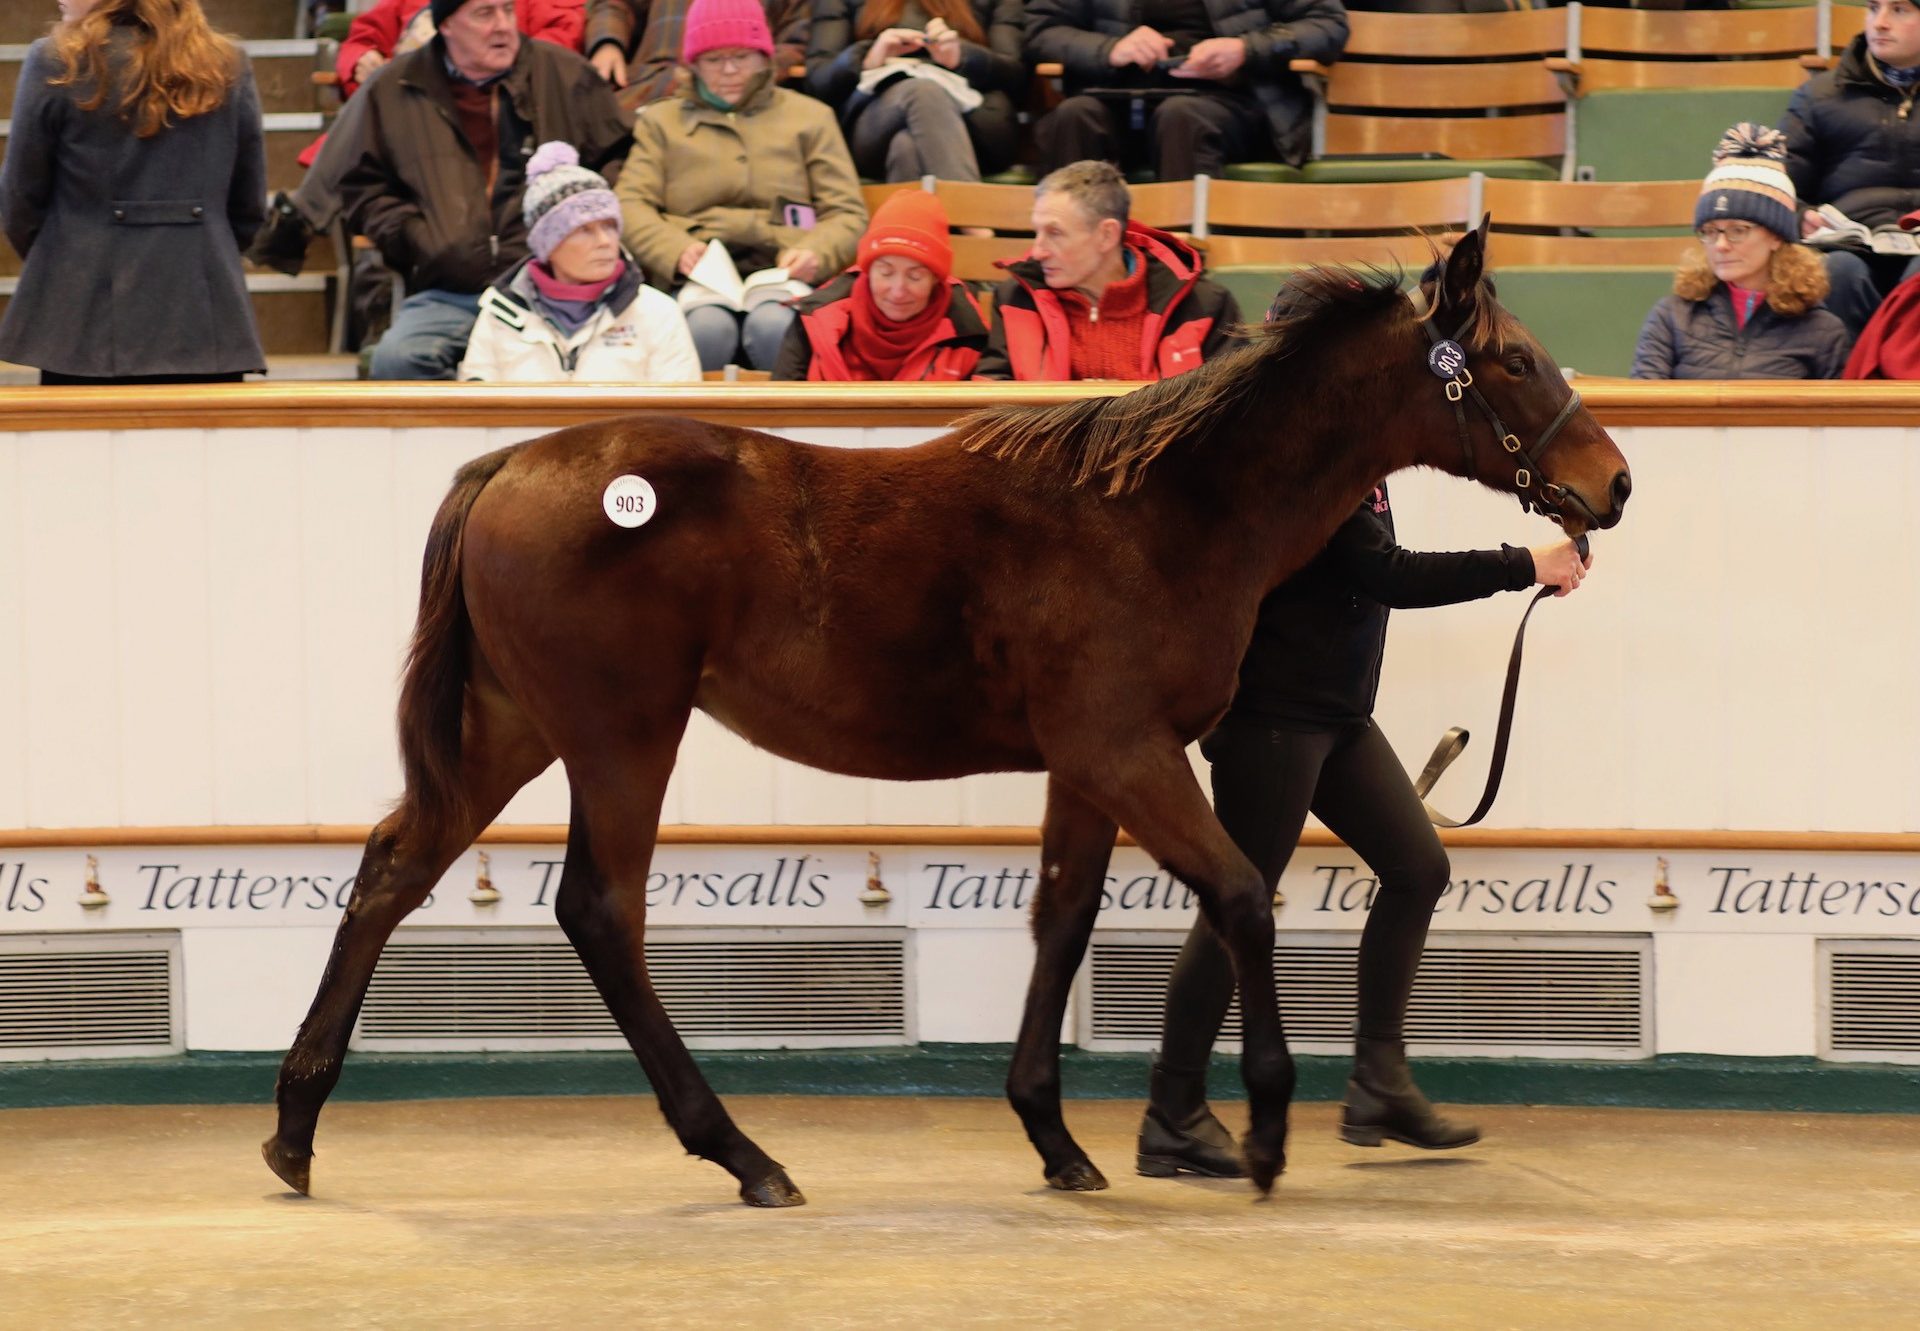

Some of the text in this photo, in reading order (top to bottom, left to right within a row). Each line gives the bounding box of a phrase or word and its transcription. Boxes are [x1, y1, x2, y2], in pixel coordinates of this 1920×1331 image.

[1437, 346, 1462, 375] 903
[615, 495, 644, 513] 903
[528, 856, 830, 908] Tersalls
